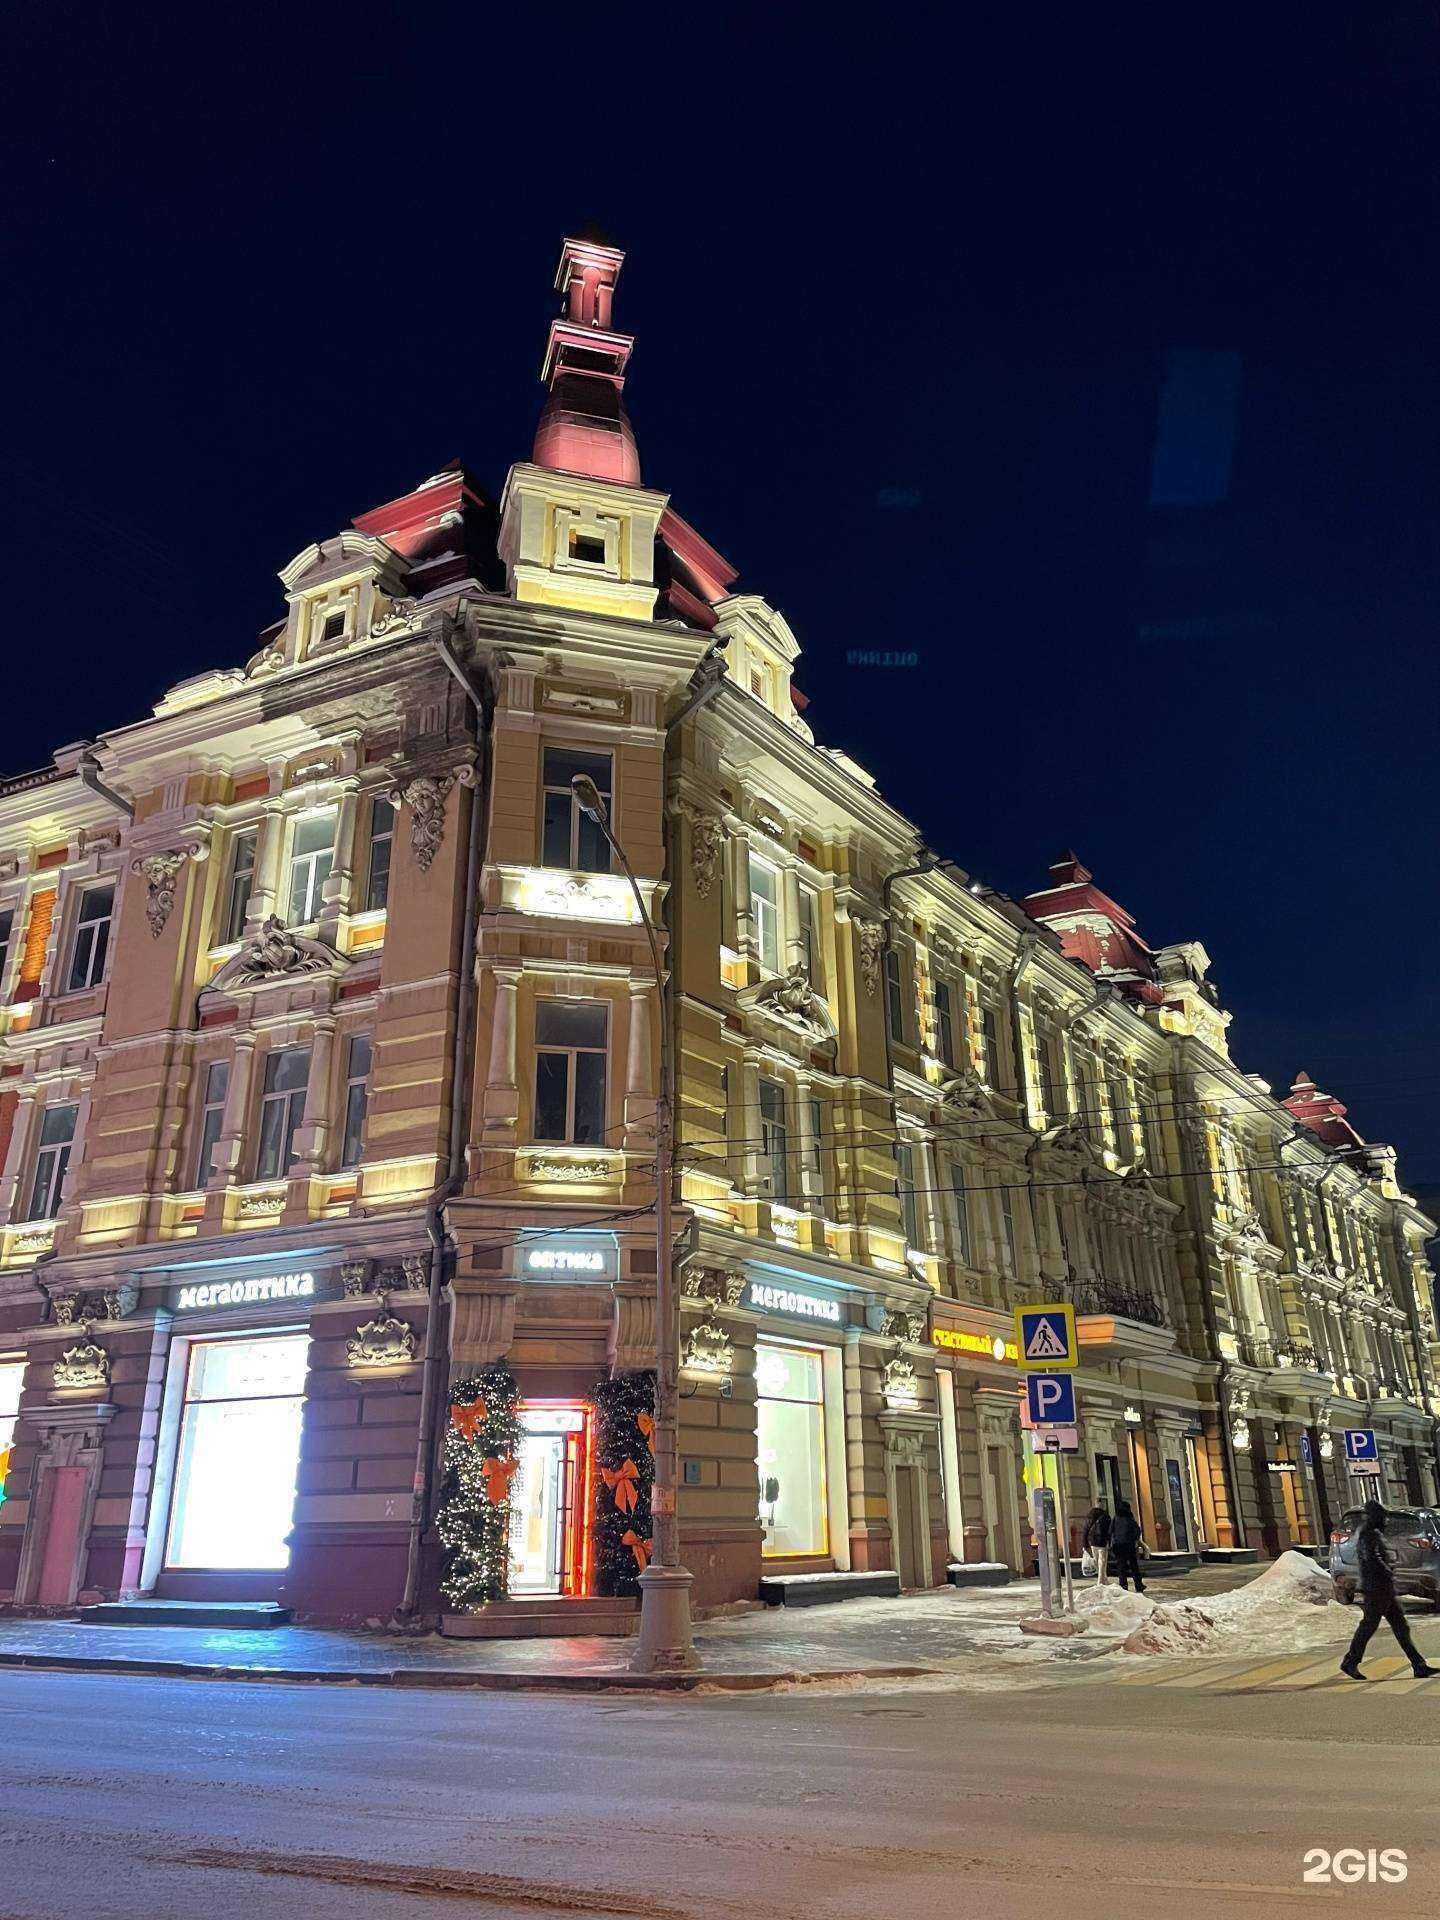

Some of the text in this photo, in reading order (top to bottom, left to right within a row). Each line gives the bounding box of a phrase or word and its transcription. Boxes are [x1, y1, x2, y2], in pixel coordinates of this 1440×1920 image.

[177, 1272, 315, 1309] мегаоптика
[750, 1282, 840, 1322] мегаоптика
[1036, 1379, 1063, 1418] P
[1350, 1432, 1368, 1456] P
